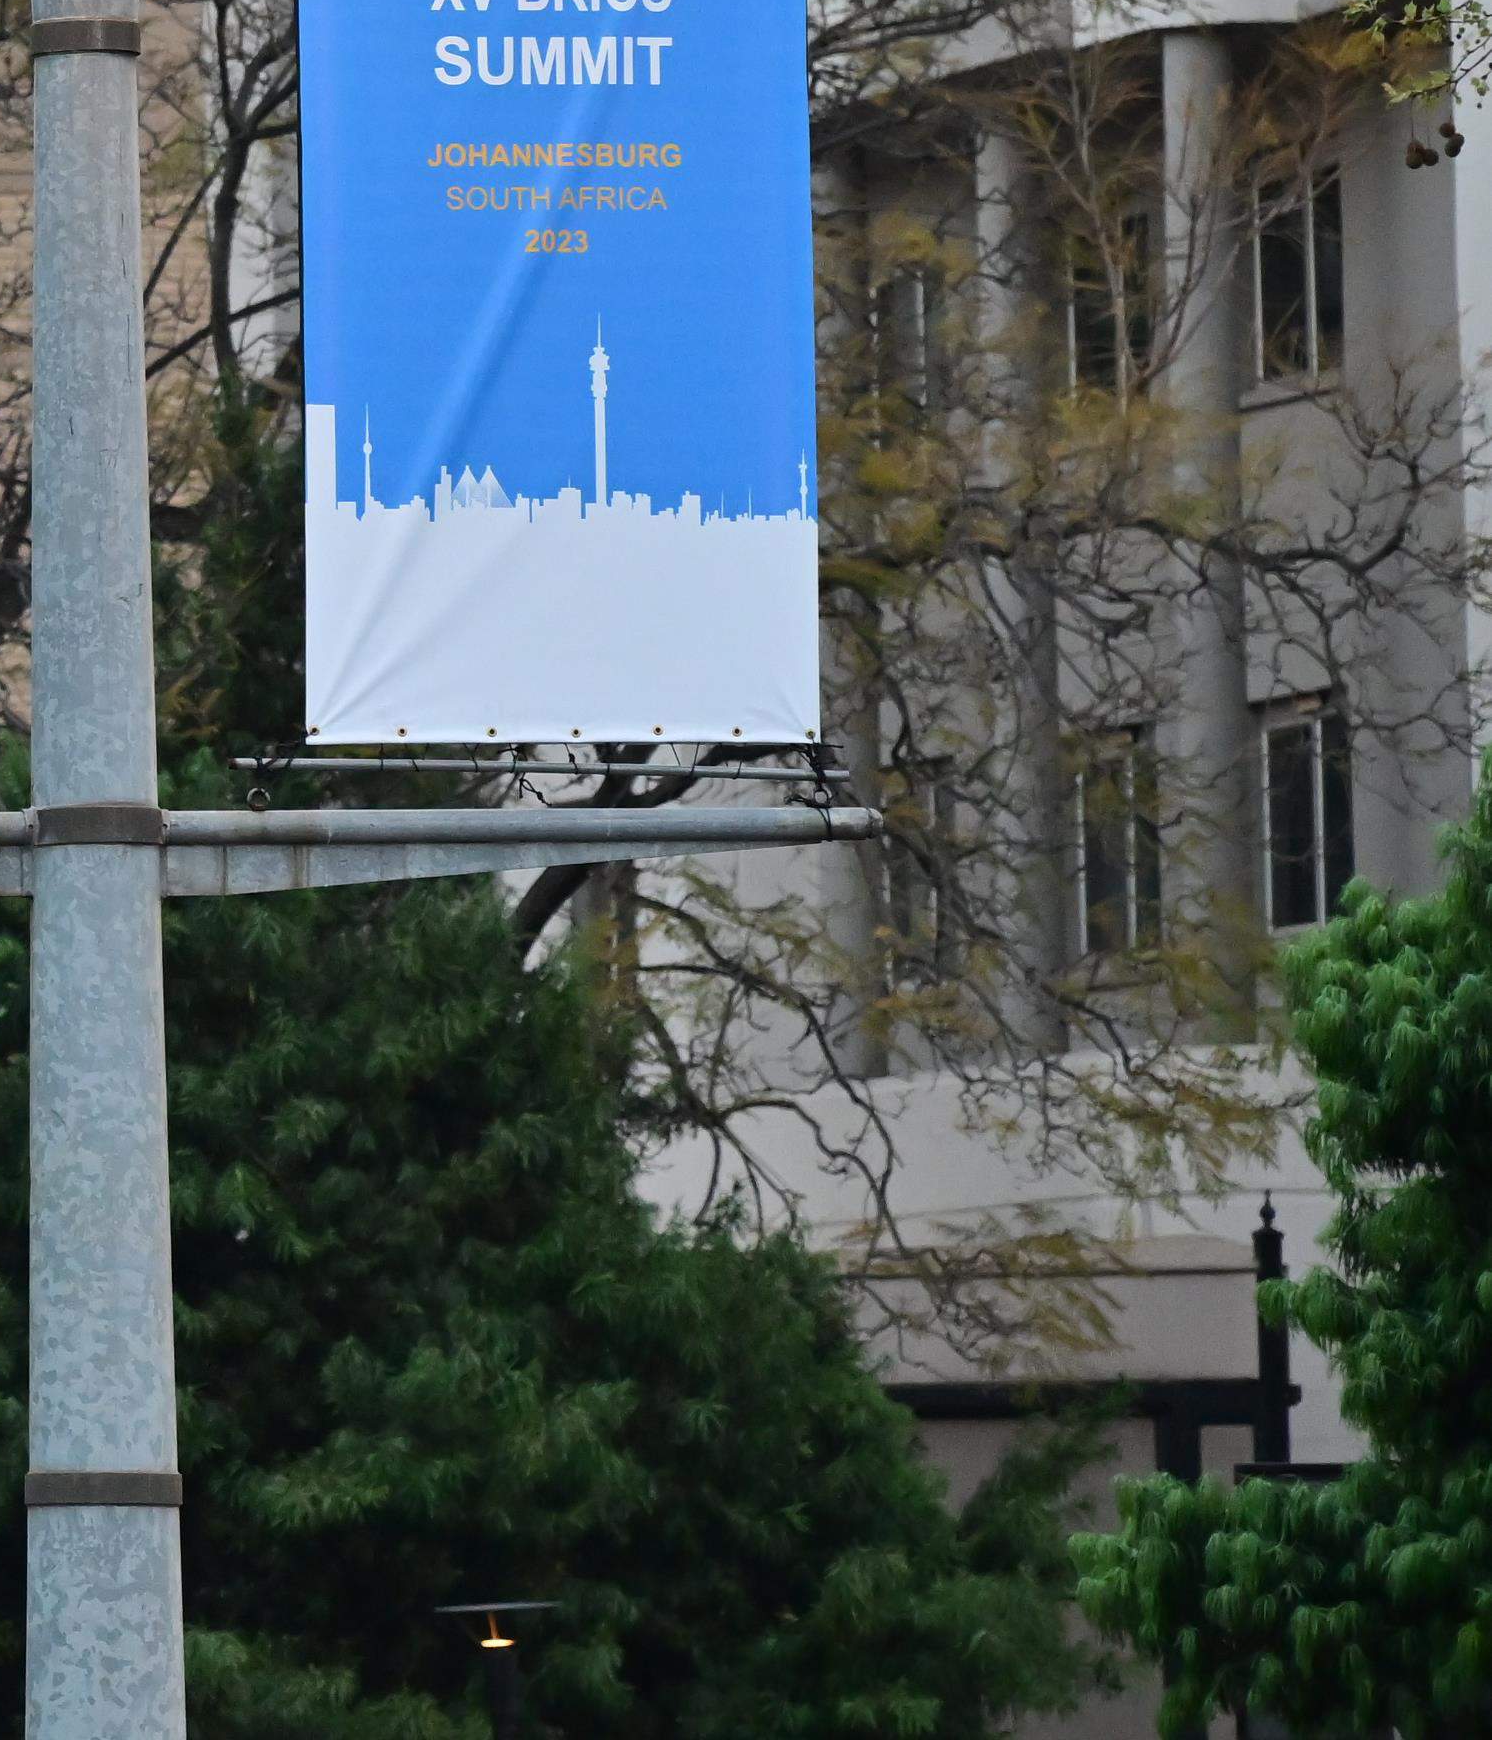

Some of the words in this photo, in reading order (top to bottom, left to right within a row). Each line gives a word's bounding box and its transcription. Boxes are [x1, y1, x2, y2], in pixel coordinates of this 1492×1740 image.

[434, 35, 673, 86] SUMMIT
[427, 142, 682, 168] JOHANNESBURG
[446, 185, 552, 211] SOUTH
[559, 186, 668, 211] AFRICA
[524, 228, 589, 253] 2023
